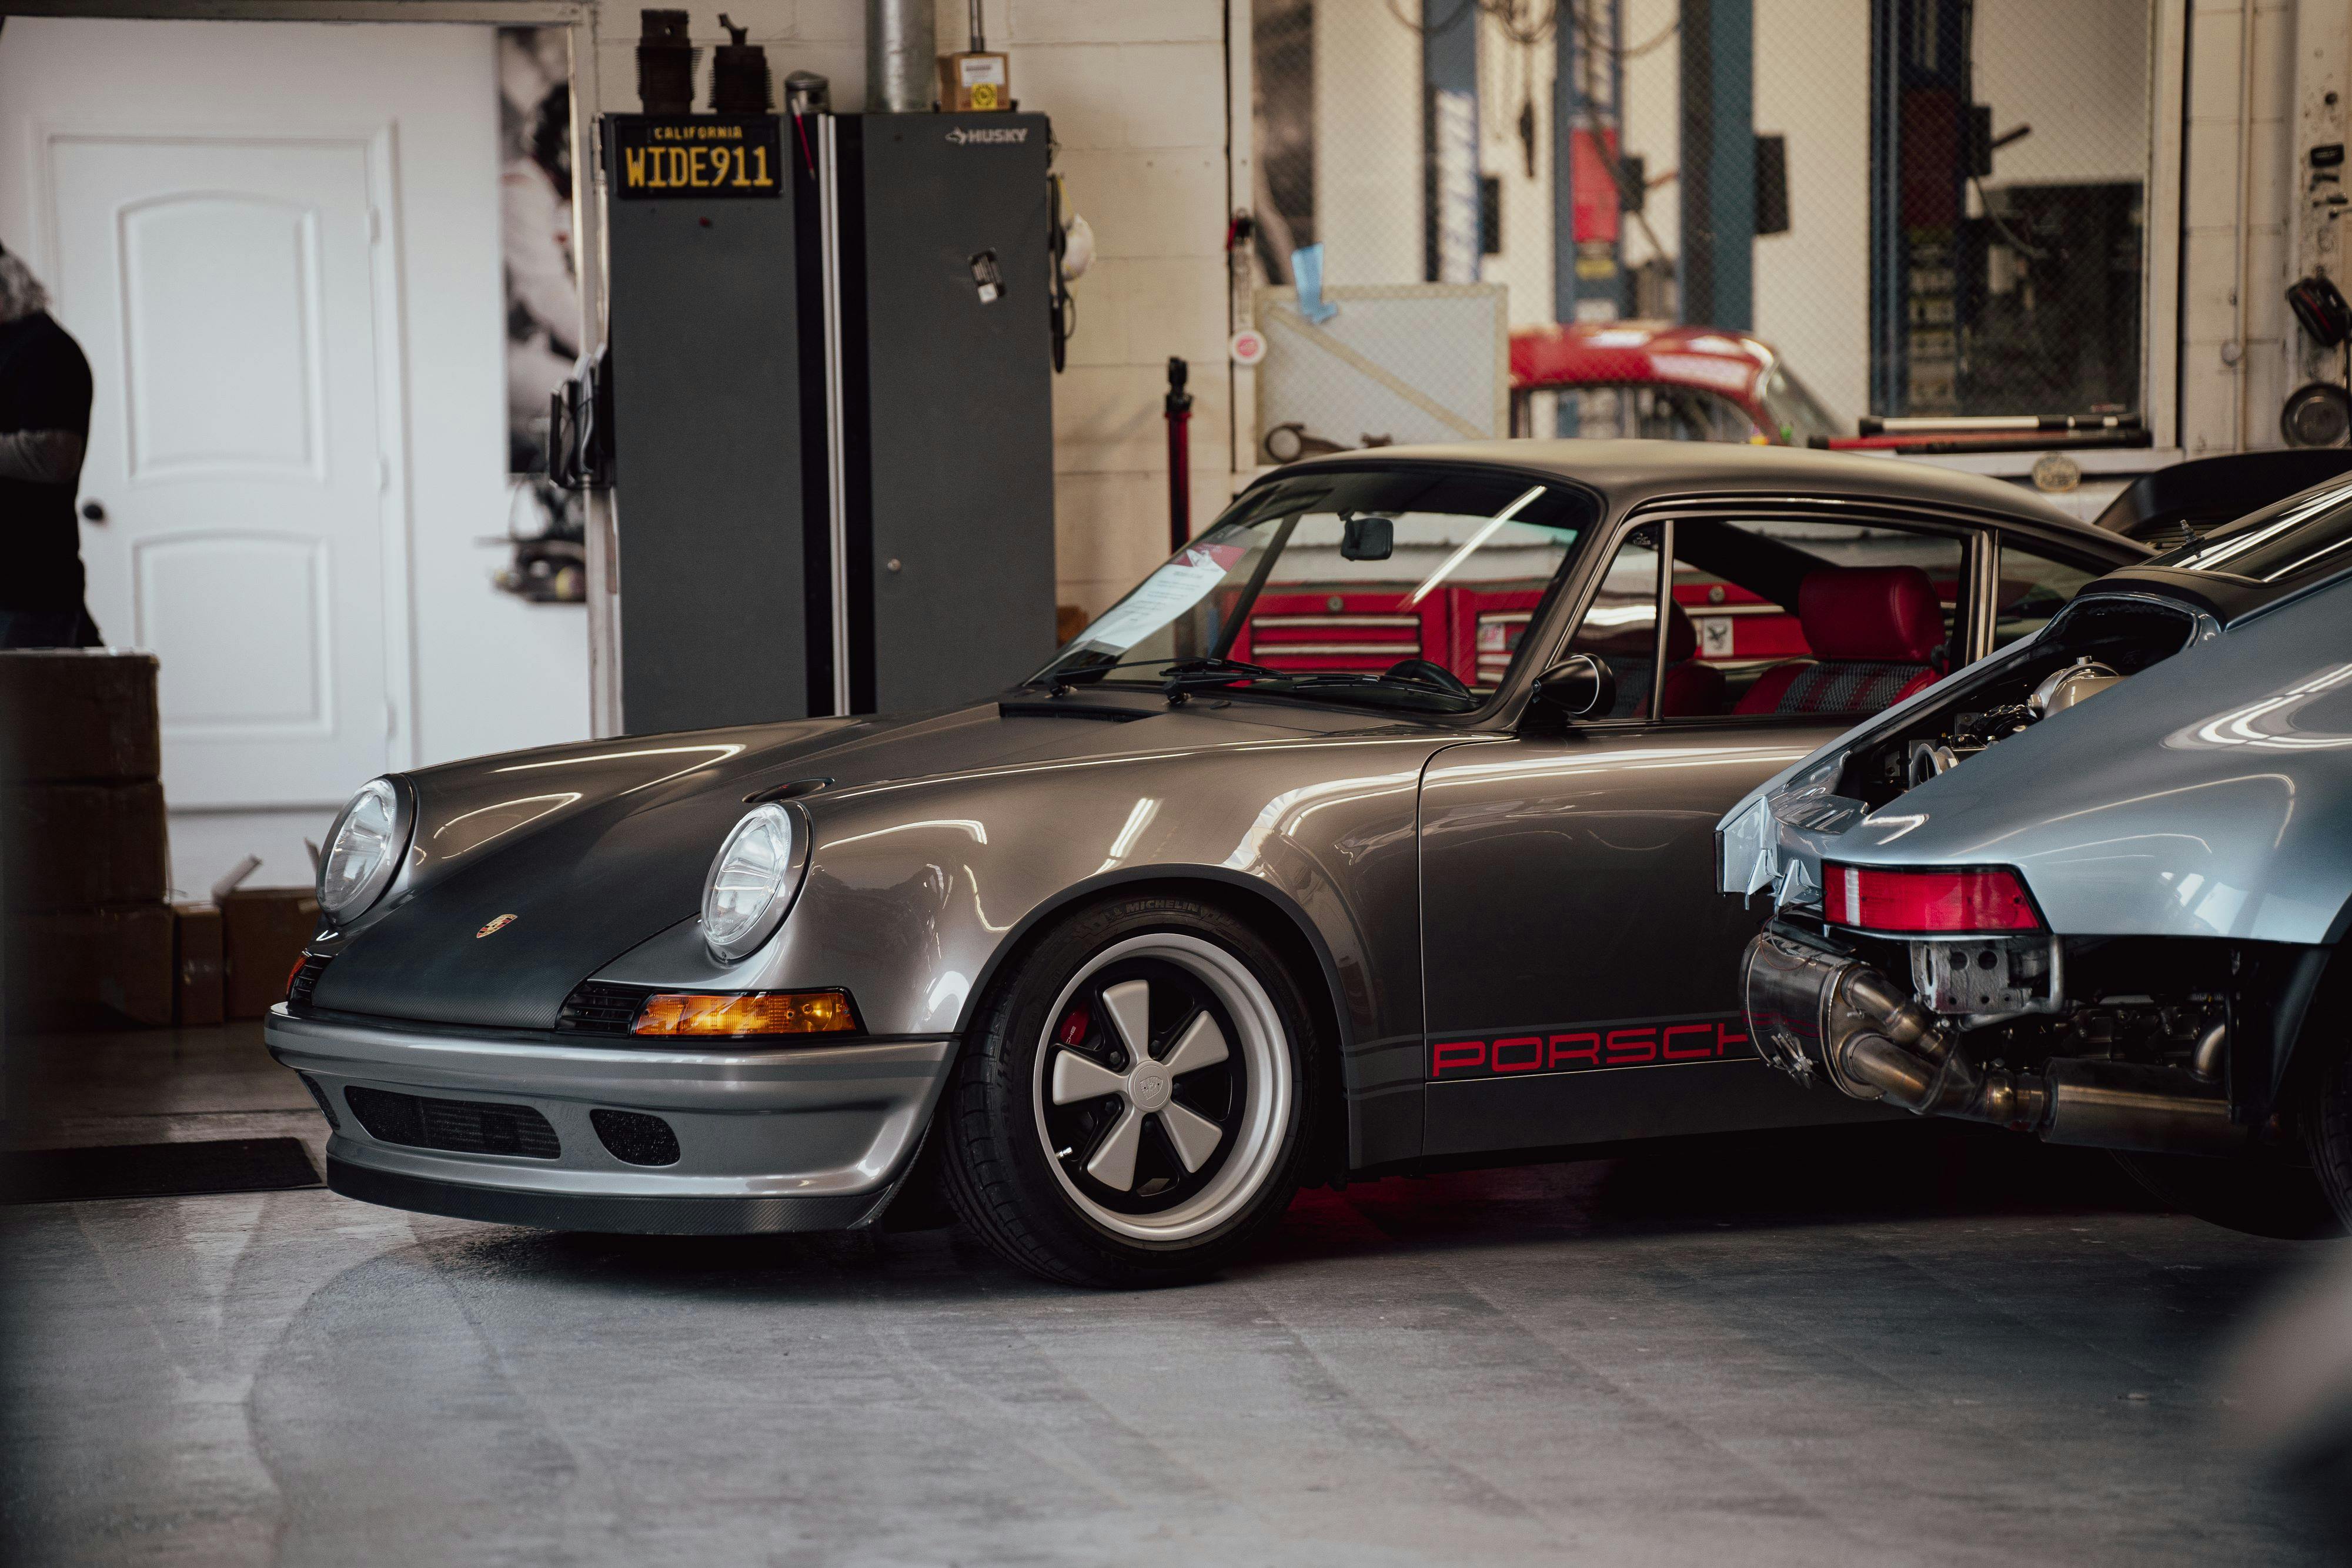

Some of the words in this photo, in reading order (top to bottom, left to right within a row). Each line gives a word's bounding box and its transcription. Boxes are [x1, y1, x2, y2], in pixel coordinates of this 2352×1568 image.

[654, 125, 743, 141] CALIFORNIA
[968, 128, 1028, 143] HUSKY
[625, 146, 774, 188] WIDE911
[1125, 900, 1199, 913] MICHELIN
[1432, 1023, 1748, 1076] PORSCH
